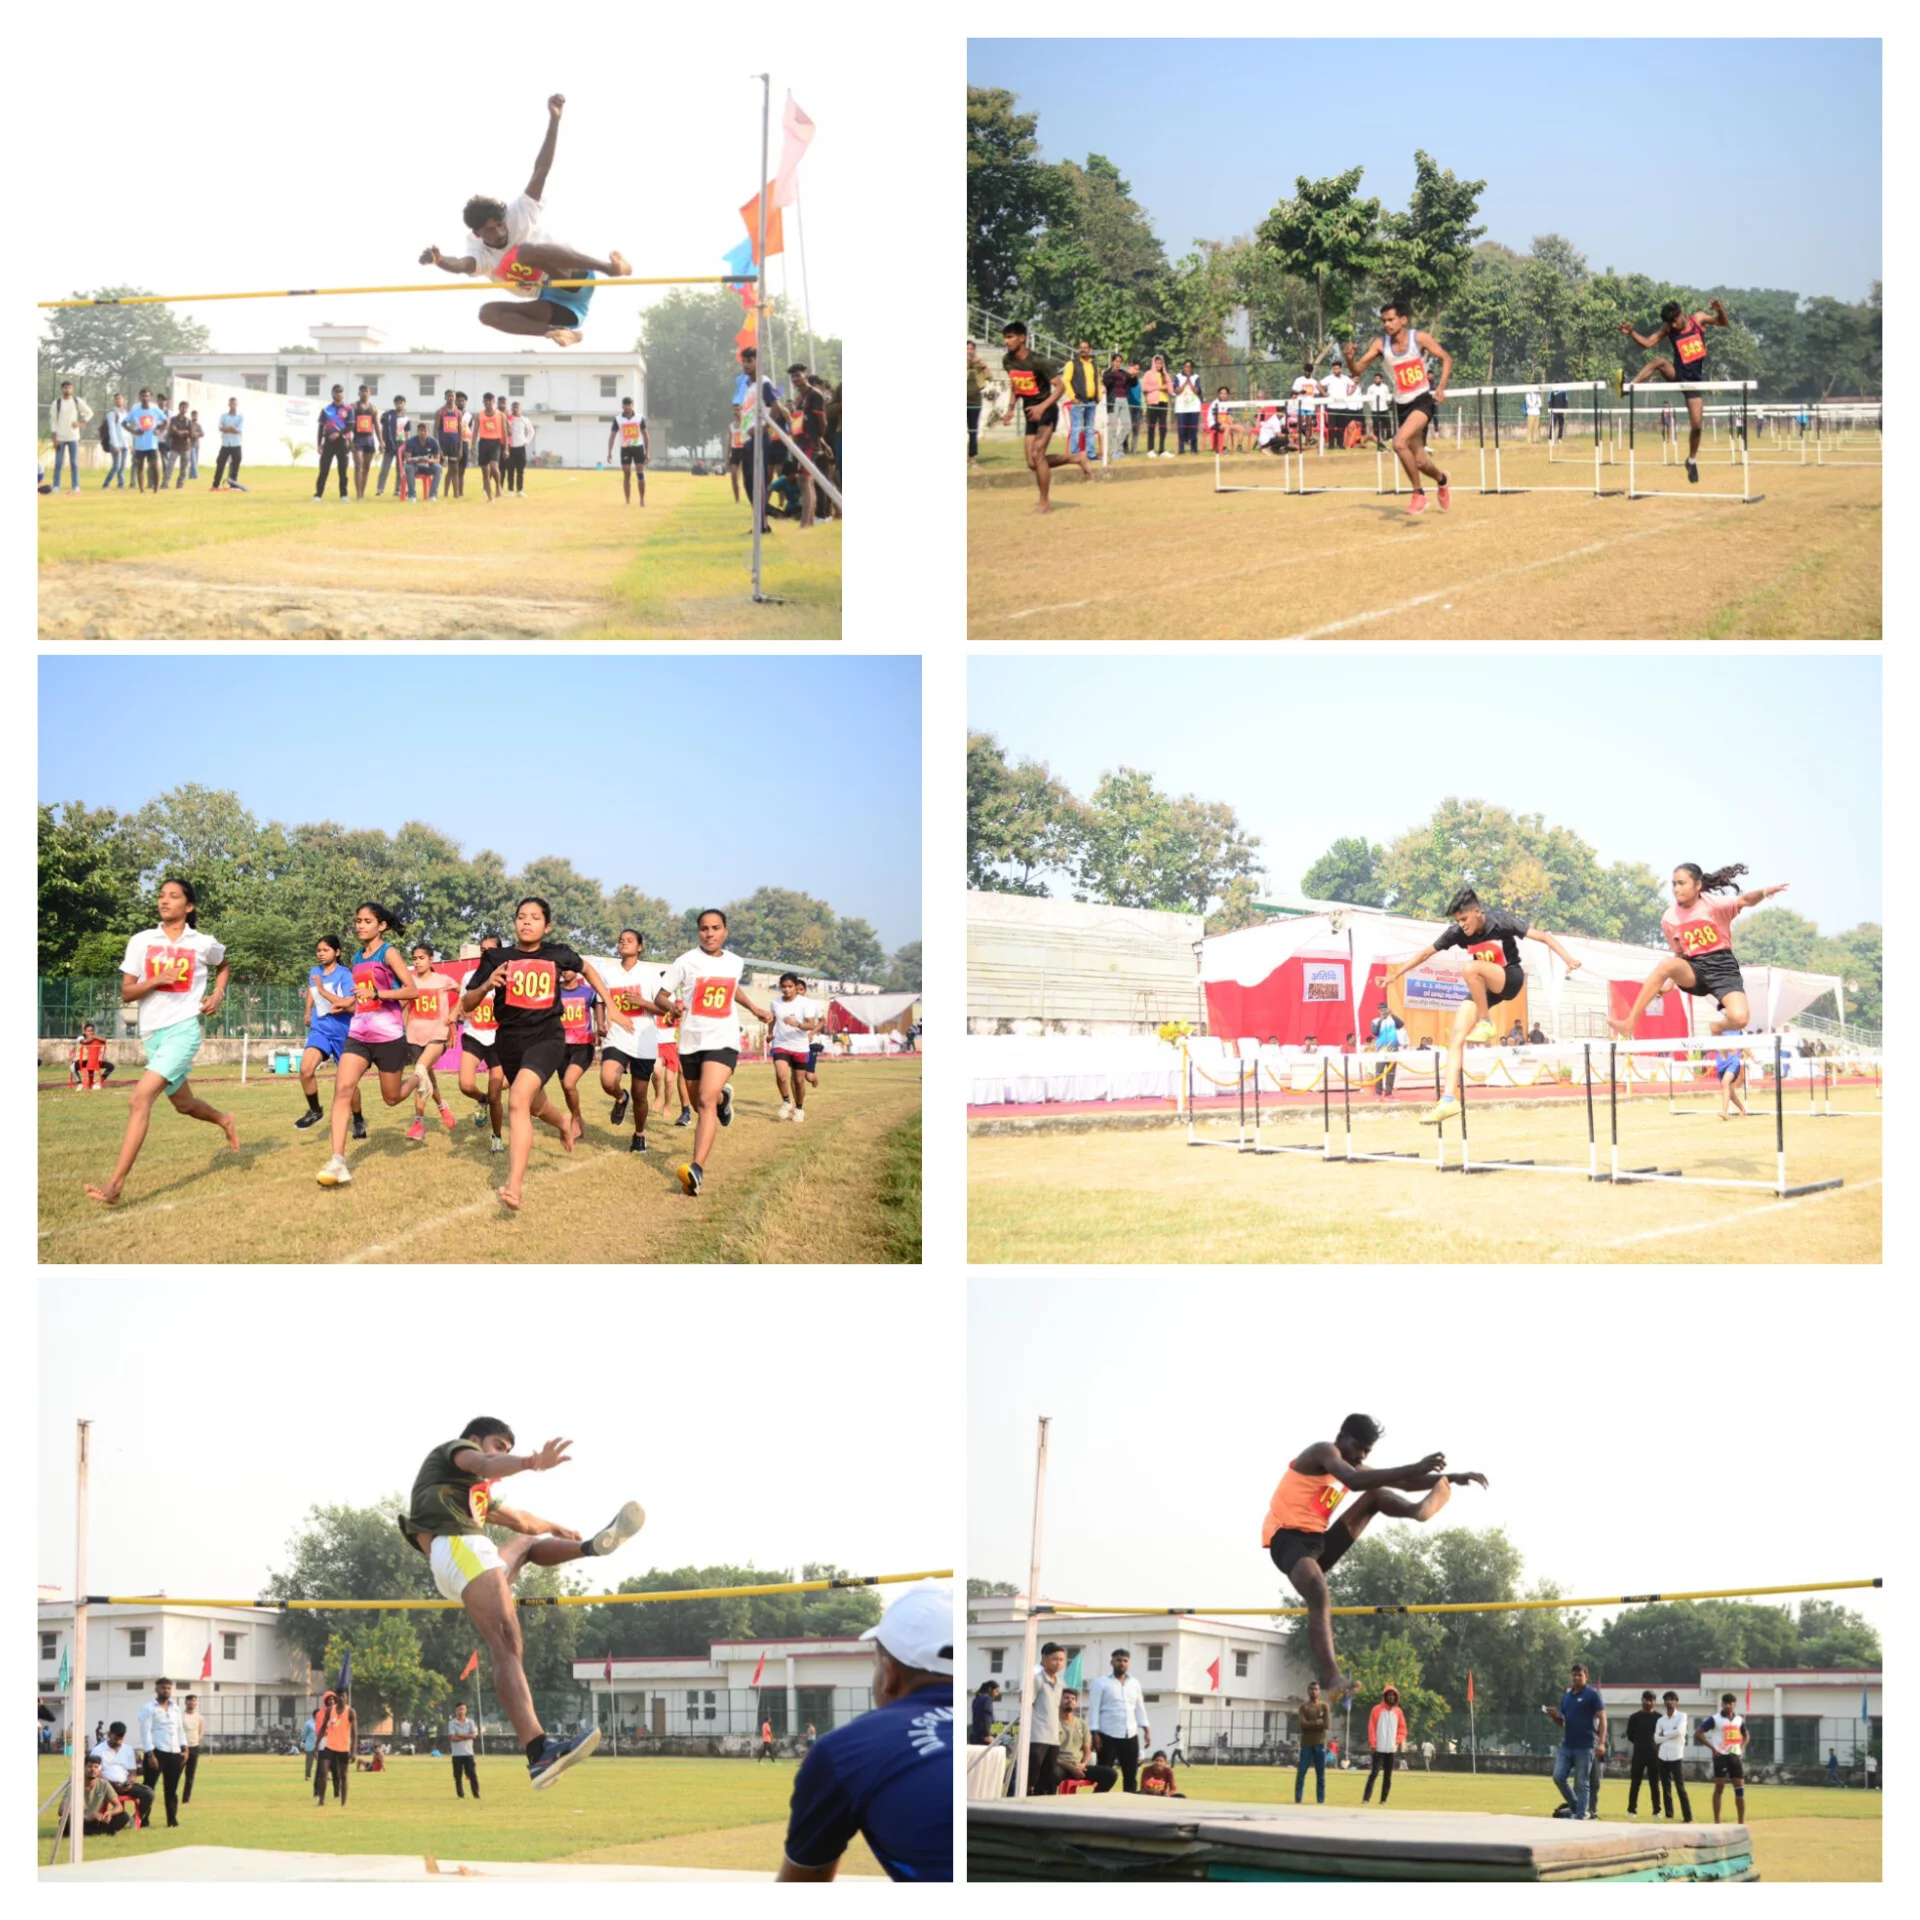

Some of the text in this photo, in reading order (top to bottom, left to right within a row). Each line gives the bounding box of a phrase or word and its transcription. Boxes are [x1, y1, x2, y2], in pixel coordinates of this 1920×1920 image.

[1398, 364, 1423, 386] 186
[1684, 925, 1718, 949] 238
[512, 970, 551, 998] 309
[415, 996, 437, 1012] 154
[703, 986, 726, 1009] 56
[475, 1004, 496, 1023] 39
